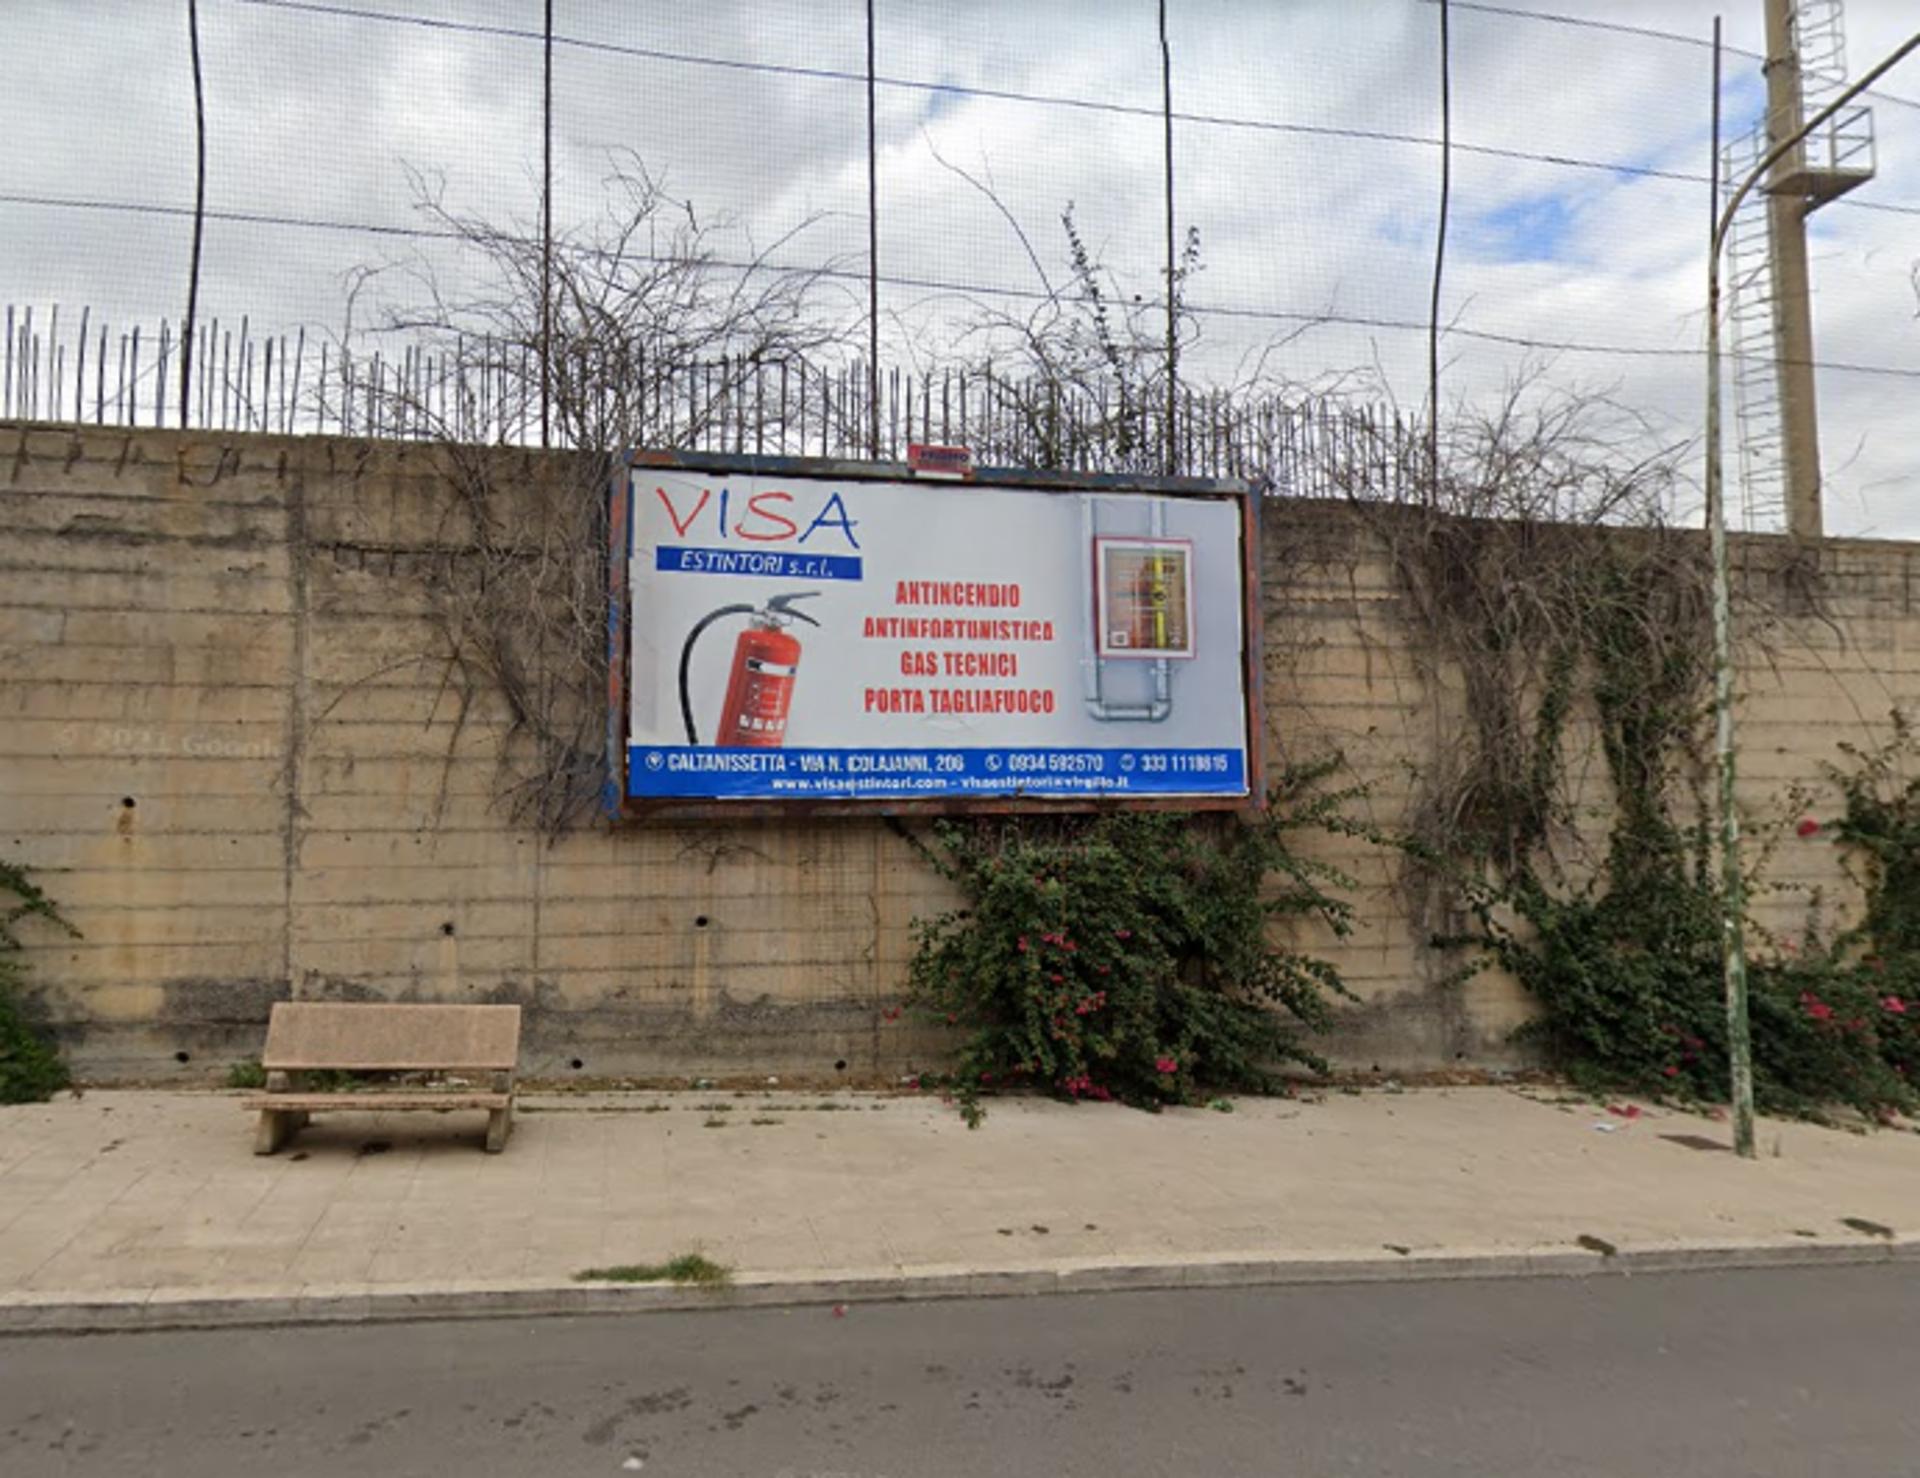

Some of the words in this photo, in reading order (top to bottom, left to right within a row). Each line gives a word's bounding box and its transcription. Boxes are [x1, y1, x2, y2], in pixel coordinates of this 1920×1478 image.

[657, 487, 860, 549] VISA
[680, 551, 784, 574] ESTINTORI
[788, 559, 834, 578] s.r.l.
[896, 581, 1020, 607] ANTINCENDIO
[863, 617, 1054, 640] ANTINFORTUNISTICA
[901, 651, 938, 676] GAS
[943, 652, 1018, 677] TECNICI
[864, 688, 925, 713] PORTA
[929, 689, 1055, 713] TAGLIAFUOCO
[667, 753, 786, 772] CALTANISSETTA
[800, 755, 824, 772] VIA
